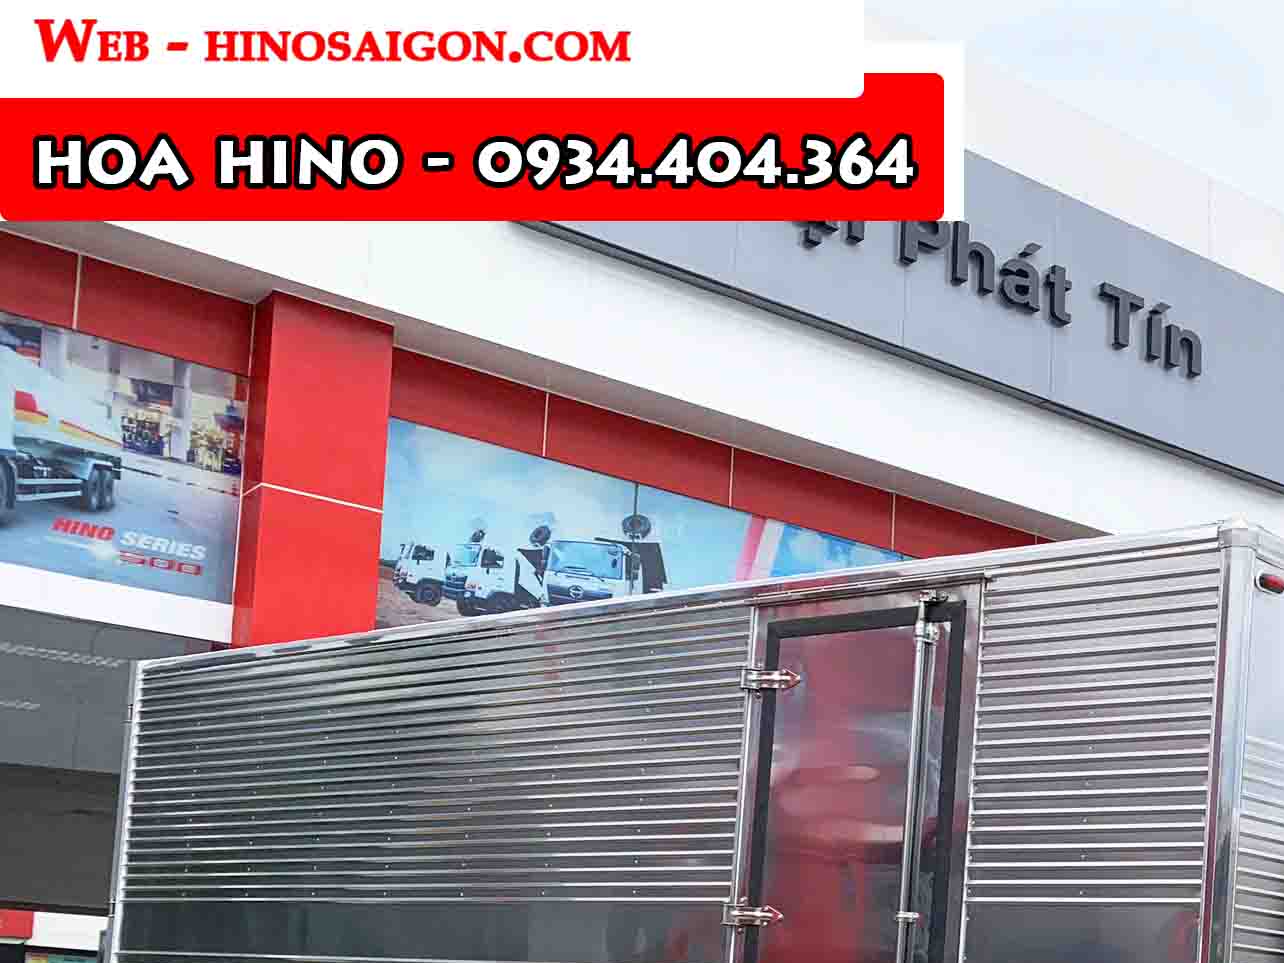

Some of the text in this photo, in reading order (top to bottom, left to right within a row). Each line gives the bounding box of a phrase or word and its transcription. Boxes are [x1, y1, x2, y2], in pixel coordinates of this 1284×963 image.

[1098, 282, 1202, 379] Tín
[52, 517, 207, 560] HINO SERIES
